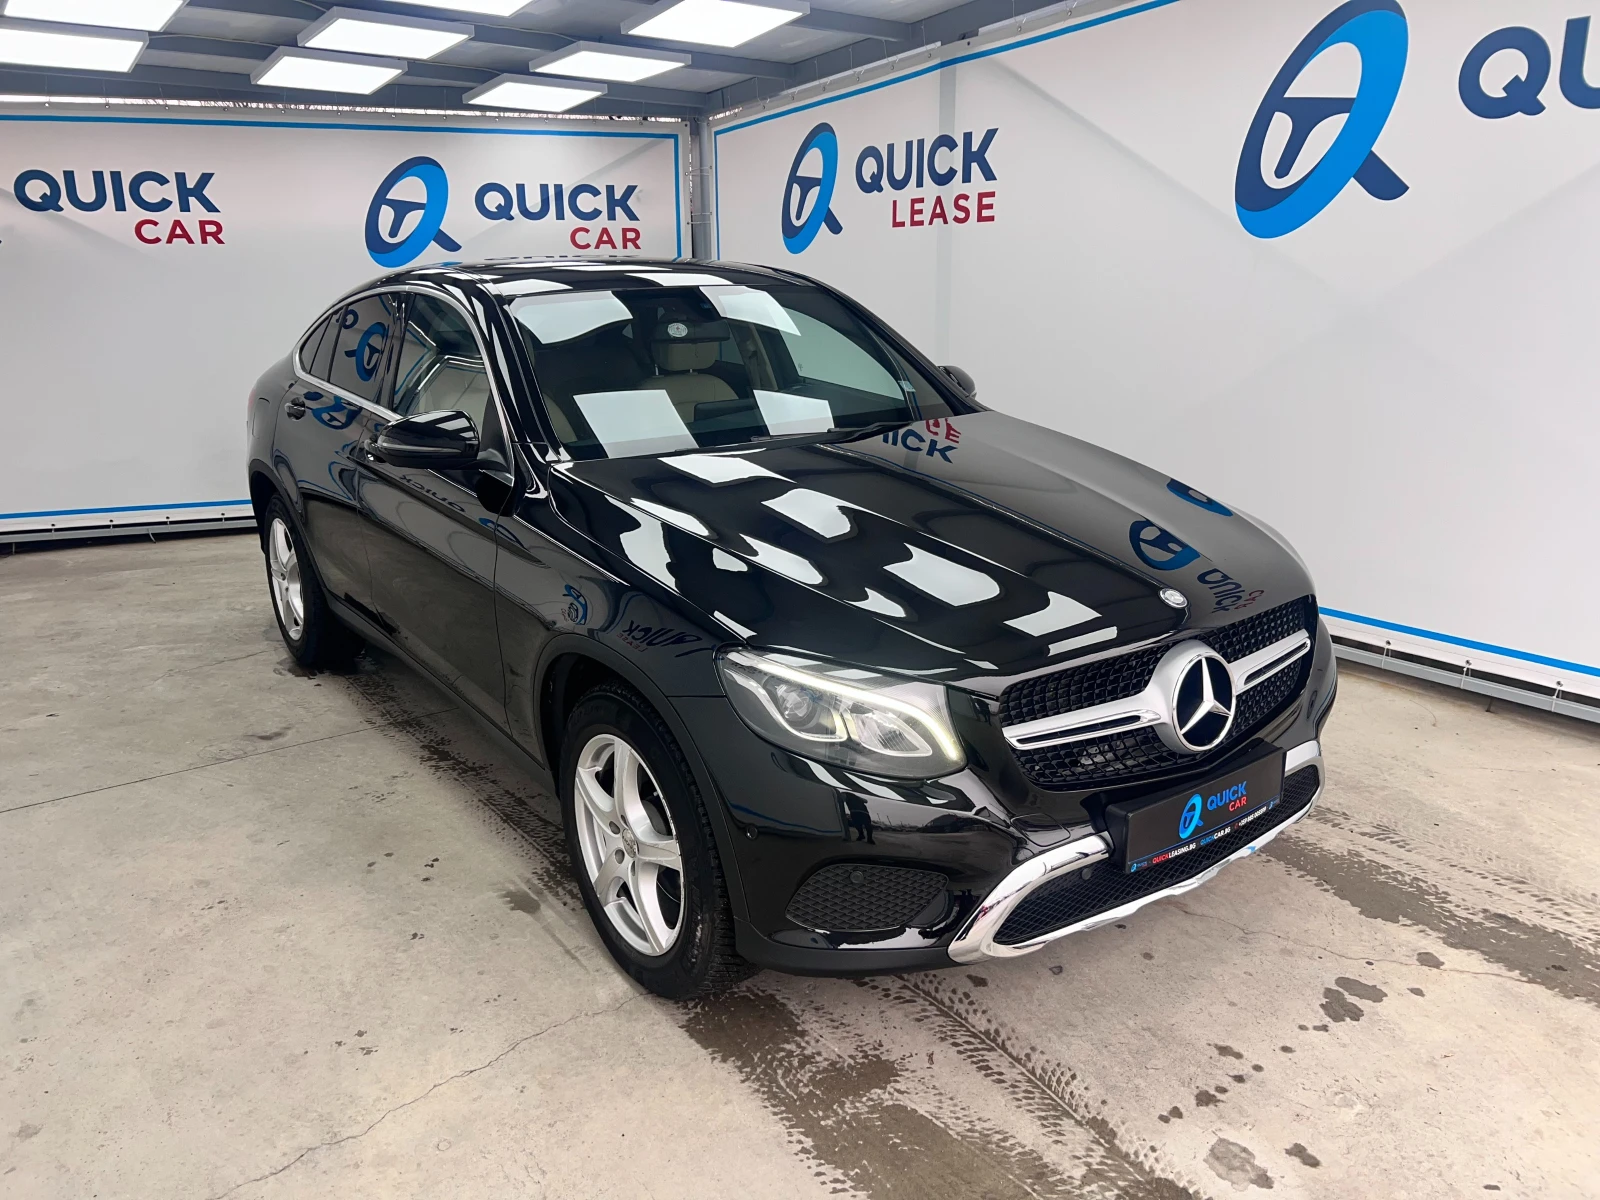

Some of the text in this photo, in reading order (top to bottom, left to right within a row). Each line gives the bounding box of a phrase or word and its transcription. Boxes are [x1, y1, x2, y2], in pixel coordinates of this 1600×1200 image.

[856, 128, 998, 194] QUICK
[14, 170, 220, 213] QUICK
[475, 182, 640, 222] QUICK
[892, 191, 996, 228] LEASE
[134, 219, 225, 245] CAR
[570, 226, 641, 250] CAR
[1207, 782, 1247, 811] QUICK
[1229, 796, 1247, 812] CAR
